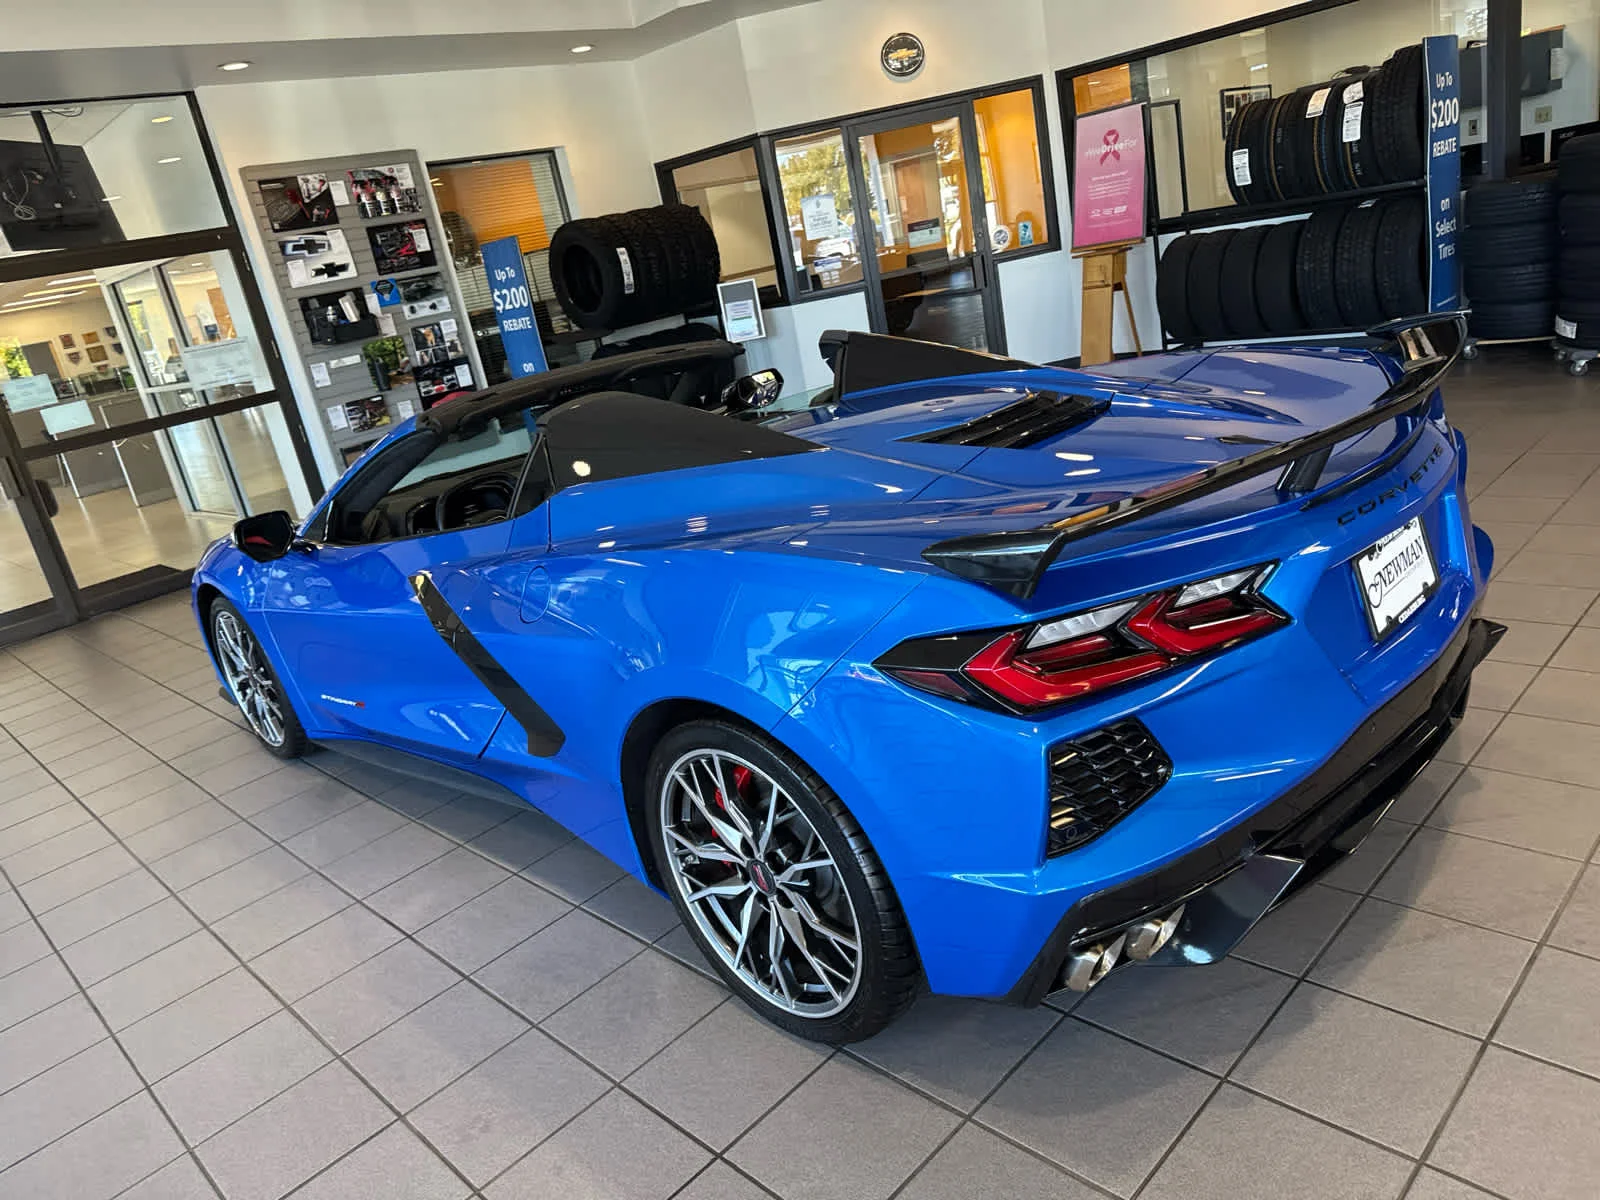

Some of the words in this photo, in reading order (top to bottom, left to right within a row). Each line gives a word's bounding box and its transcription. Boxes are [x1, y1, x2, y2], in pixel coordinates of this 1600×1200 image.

[1435, 73, 1445, 91] Up
[1445, 71, 1454, 86] To
[1431, 97, 1460, 132] $200
[1432, 137, 1457, 158] REBATE
[1440, 198, 1451, 212] on
[1435, 217, 1457, 238] Select
[1438, 243, 1456, 260] Tires
[494, 269, 507, 283] Up
[506, 266, 516, 279] To
[493, 285, 530, 314] $200
[503, 316, 533, 332] REBATE
[523, 362, 535, 373] on
[1337, 442, 1444, 527] CORVETTE
[1368, 536, 1425, 608] NEWMAN
